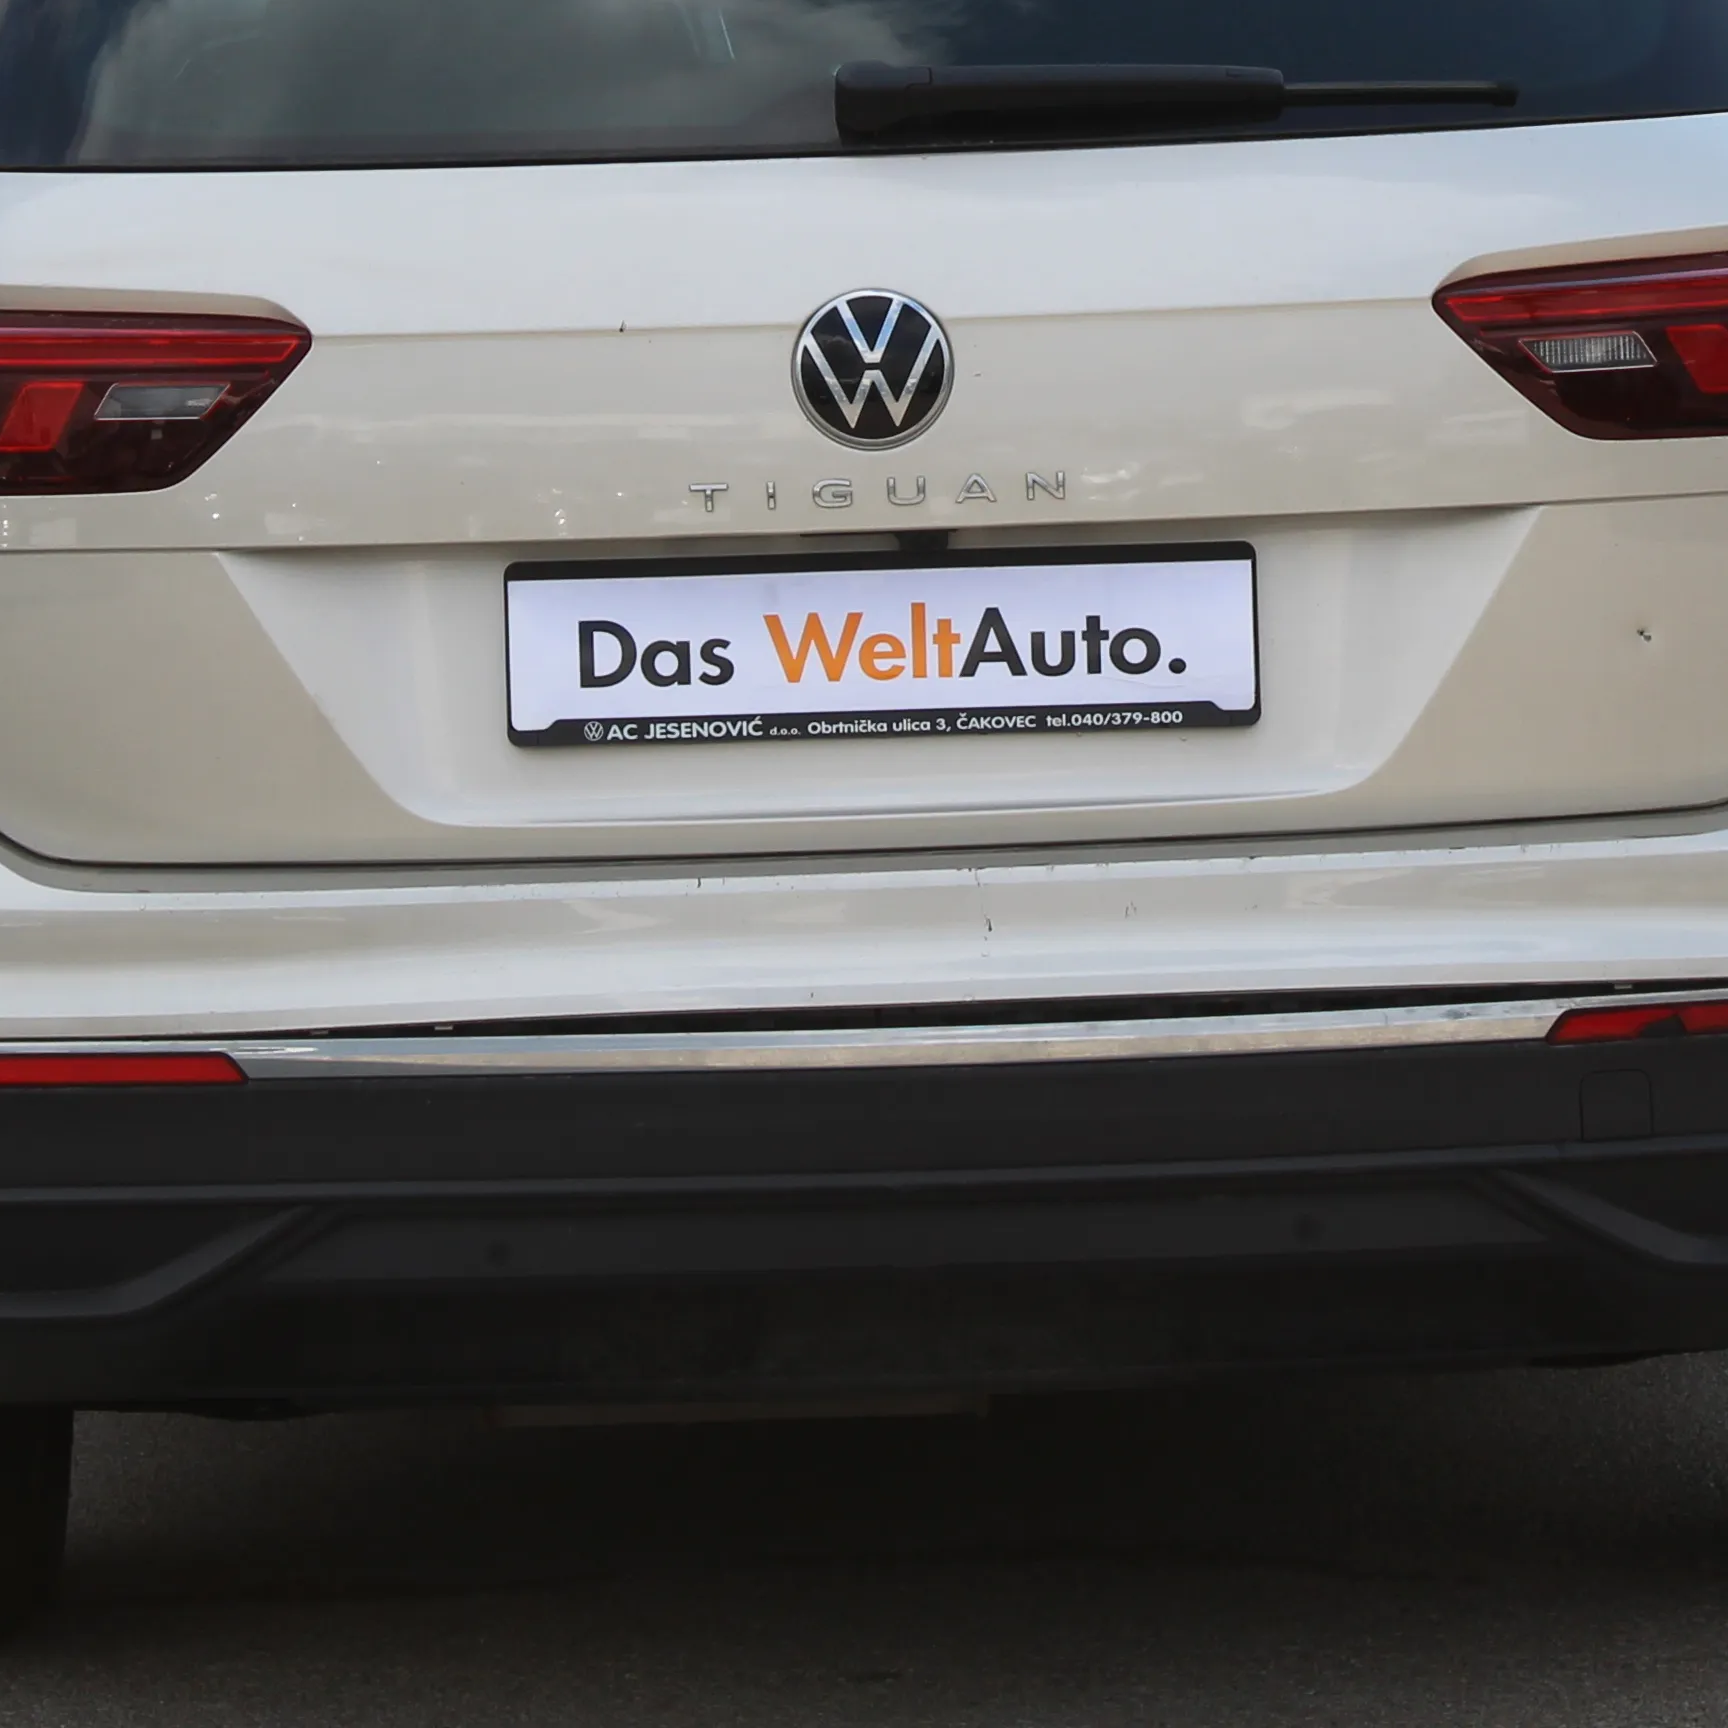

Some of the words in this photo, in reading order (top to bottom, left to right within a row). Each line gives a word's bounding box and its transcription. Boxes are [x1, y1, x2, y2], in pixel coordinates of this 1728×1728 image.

[688, 470, 1068, 513] TIGUAN
[579, 620, 734, 688] Das
[764, 603, 1186, 682] WeltAuto.
[607, 724, 637, 740] AC
[644, 716, 763, 740] JESENOVIĆ
[769, 726, 801, 736] d.o.o.
[808, 720, 887, 734] Obrtnička
[893, 719, 930, 731] ulica
[937, 719, 951, 731] 3,
[957, 713, 1036, 729] ČAKOVEC
